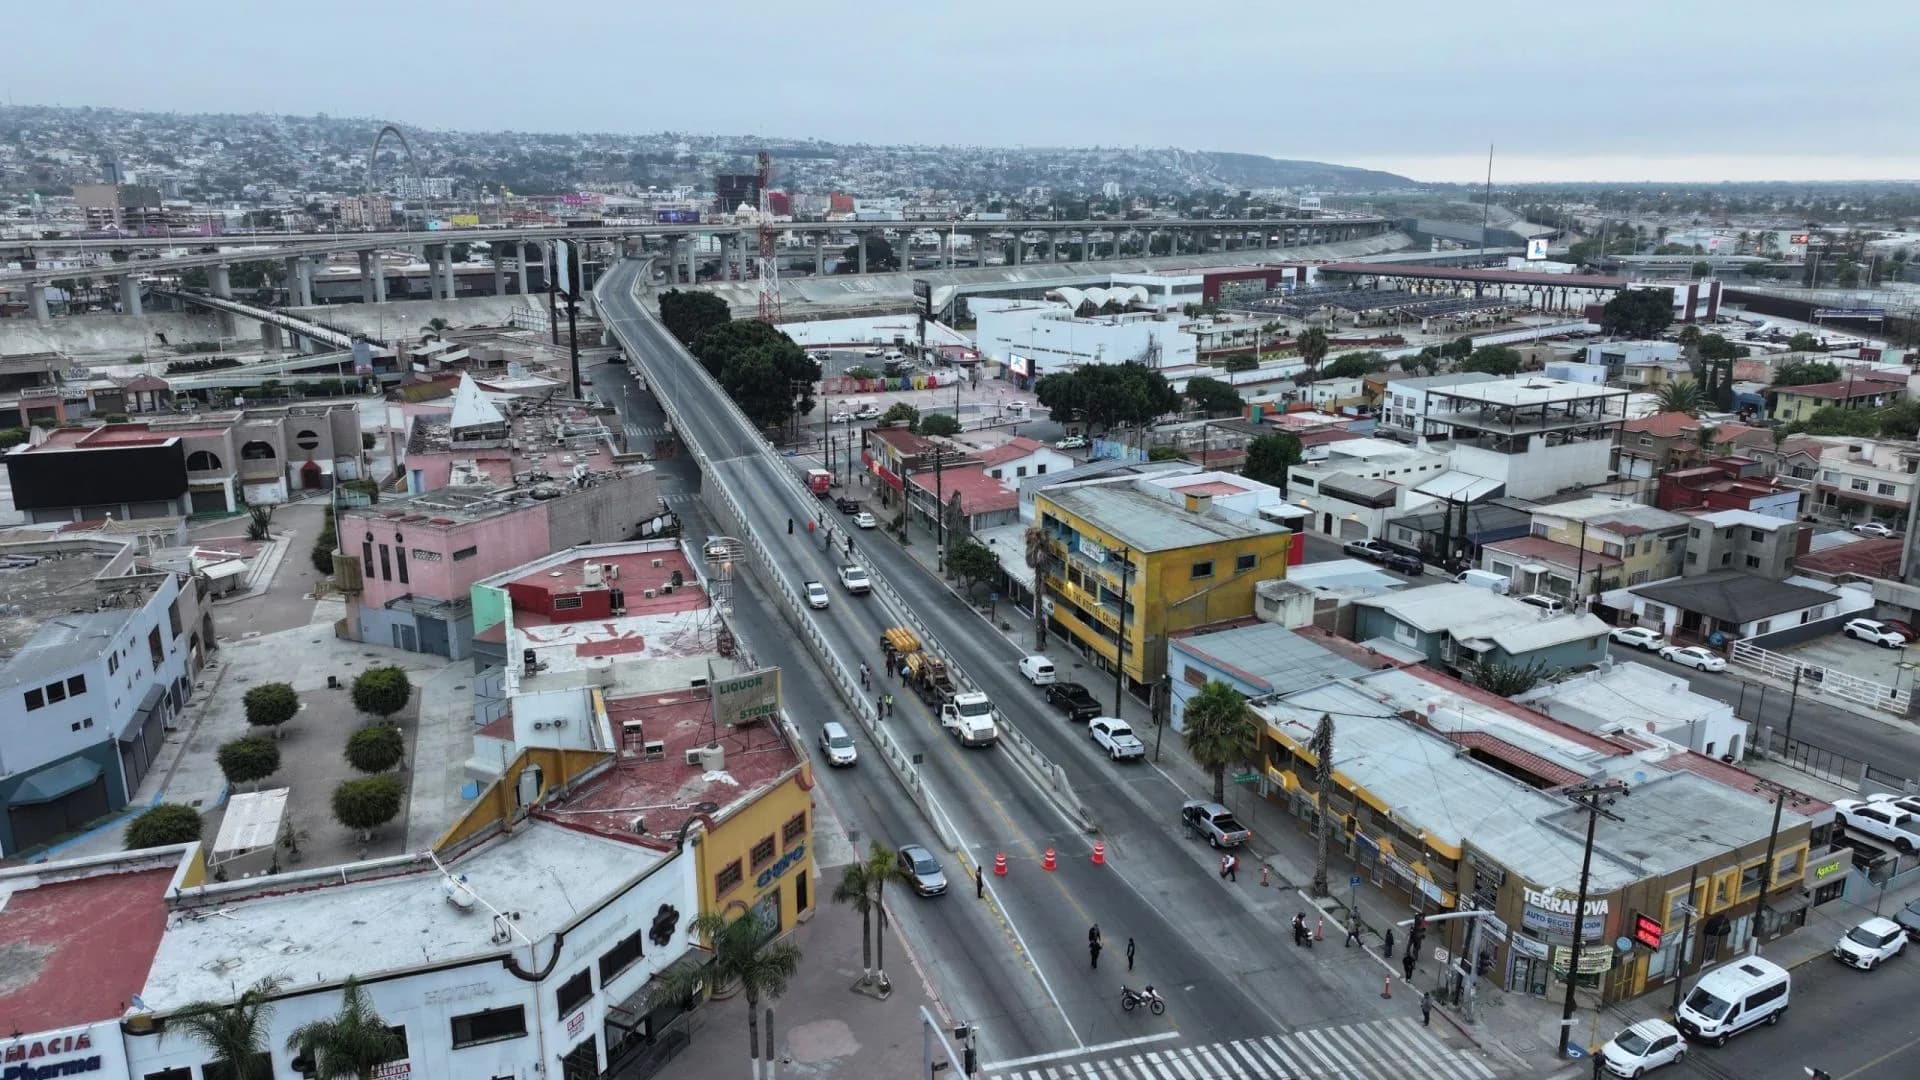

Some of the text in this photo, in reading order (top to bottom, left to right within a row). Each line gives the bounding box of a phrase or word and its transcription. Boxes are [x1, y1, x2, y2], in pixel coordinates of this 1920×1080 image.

[720, 677, 763, 695] LIQUOR
[740, 703, 776, 719] STORE
[0, 1034, 92, 1064] MACIA
